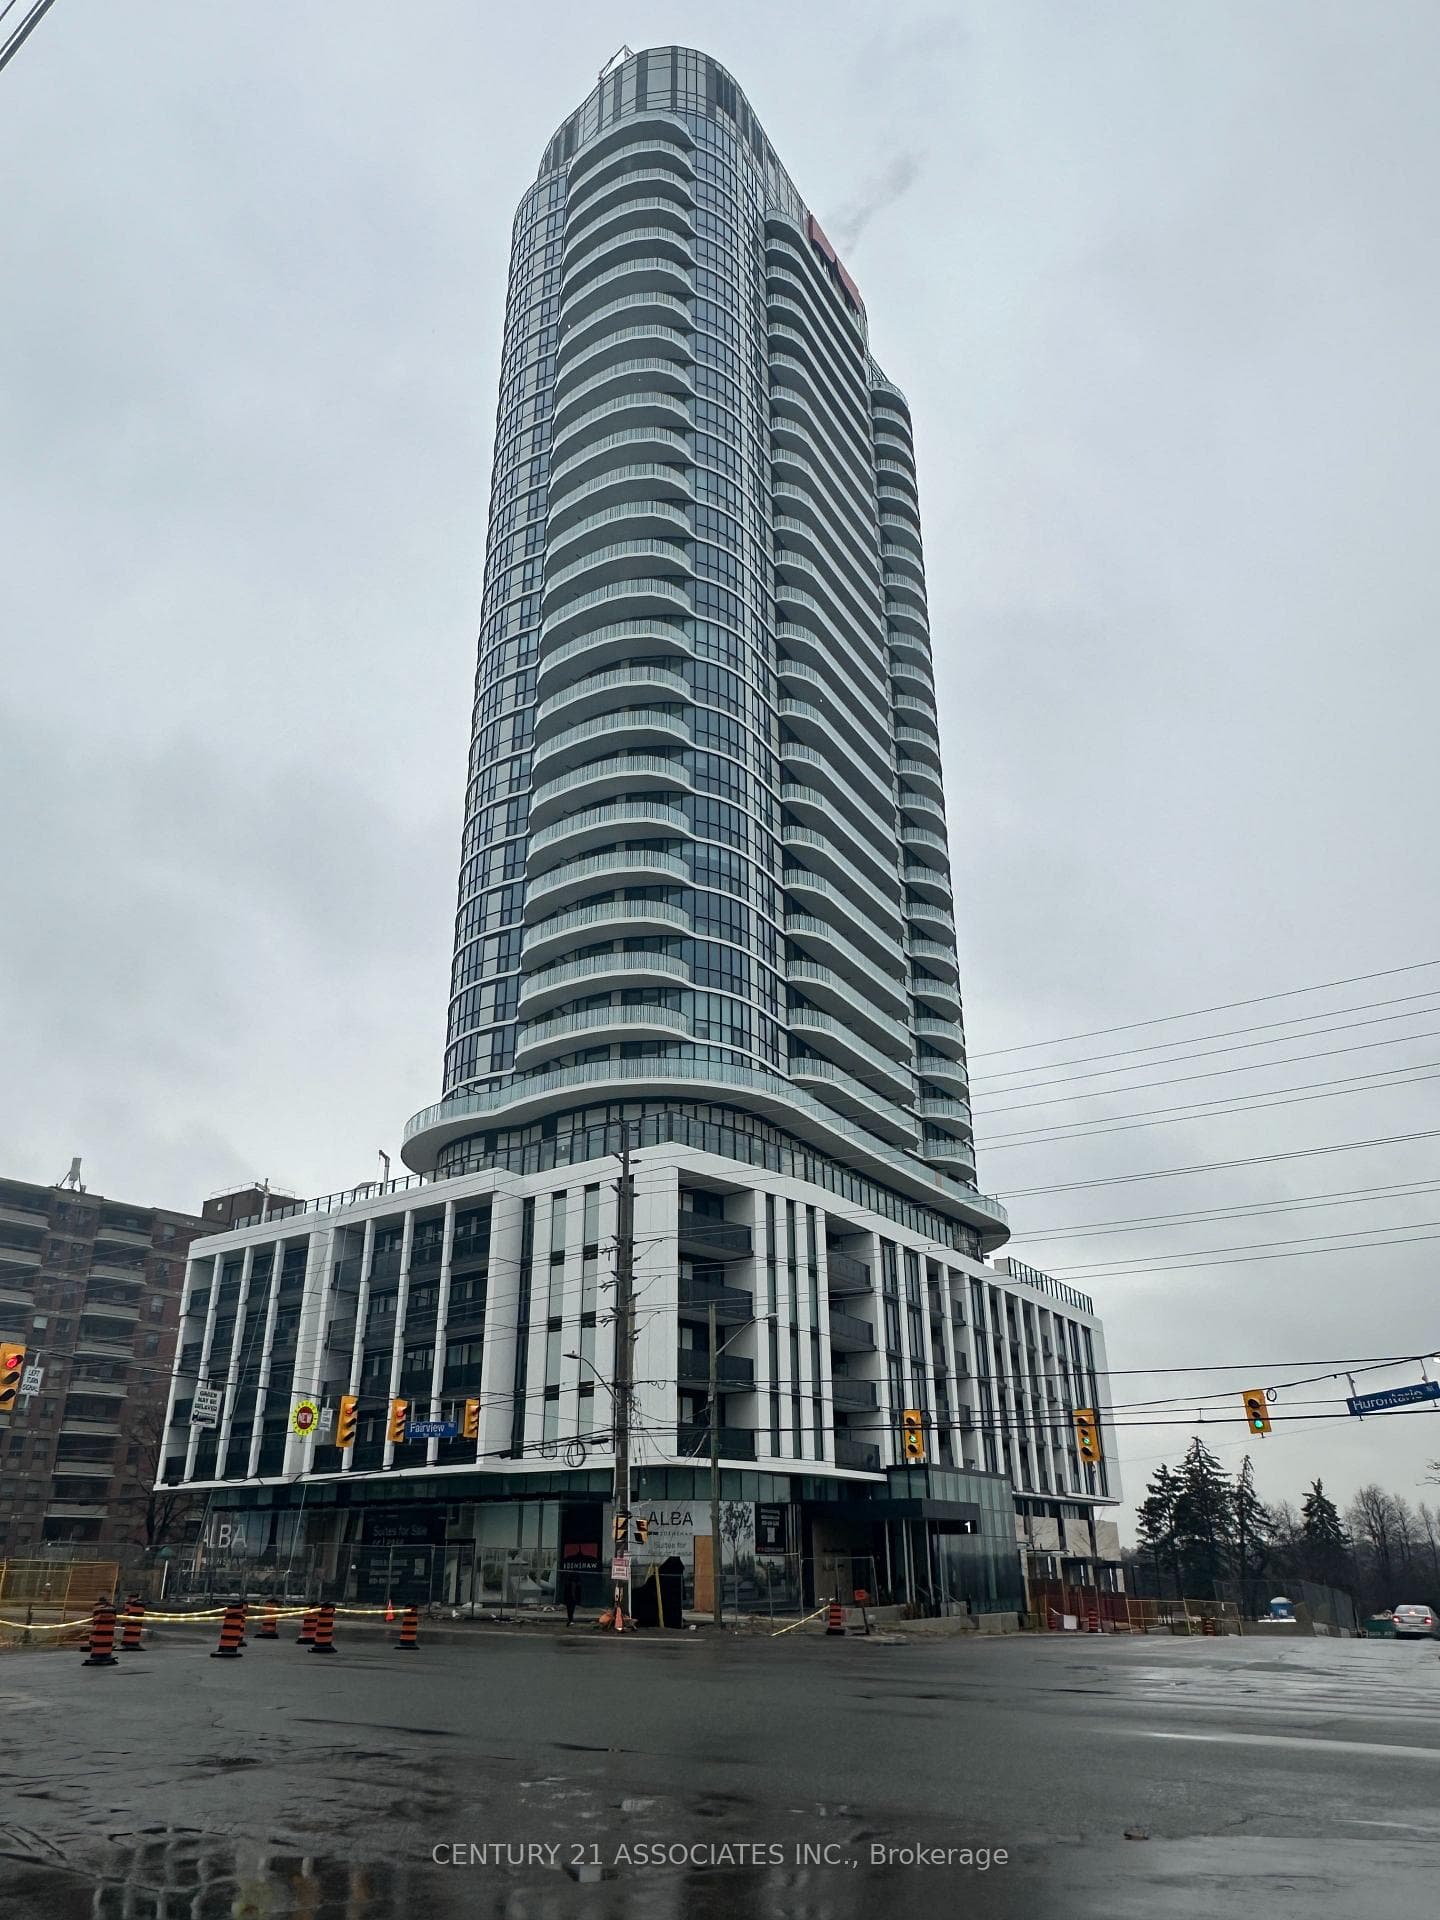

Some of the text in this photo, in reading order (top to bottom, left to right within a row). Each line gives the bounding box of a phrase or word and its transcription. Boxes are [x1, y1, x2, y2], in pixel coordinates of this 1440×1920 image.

[298, 1412, 313, 1424] NEW
[410, 1422, 445, 1433] Fairview
[648, 1511, 694, 1526] ALBA
[964, 1521, 971, 1534] 1
[203, 1523, 248, 1549] ALBA
